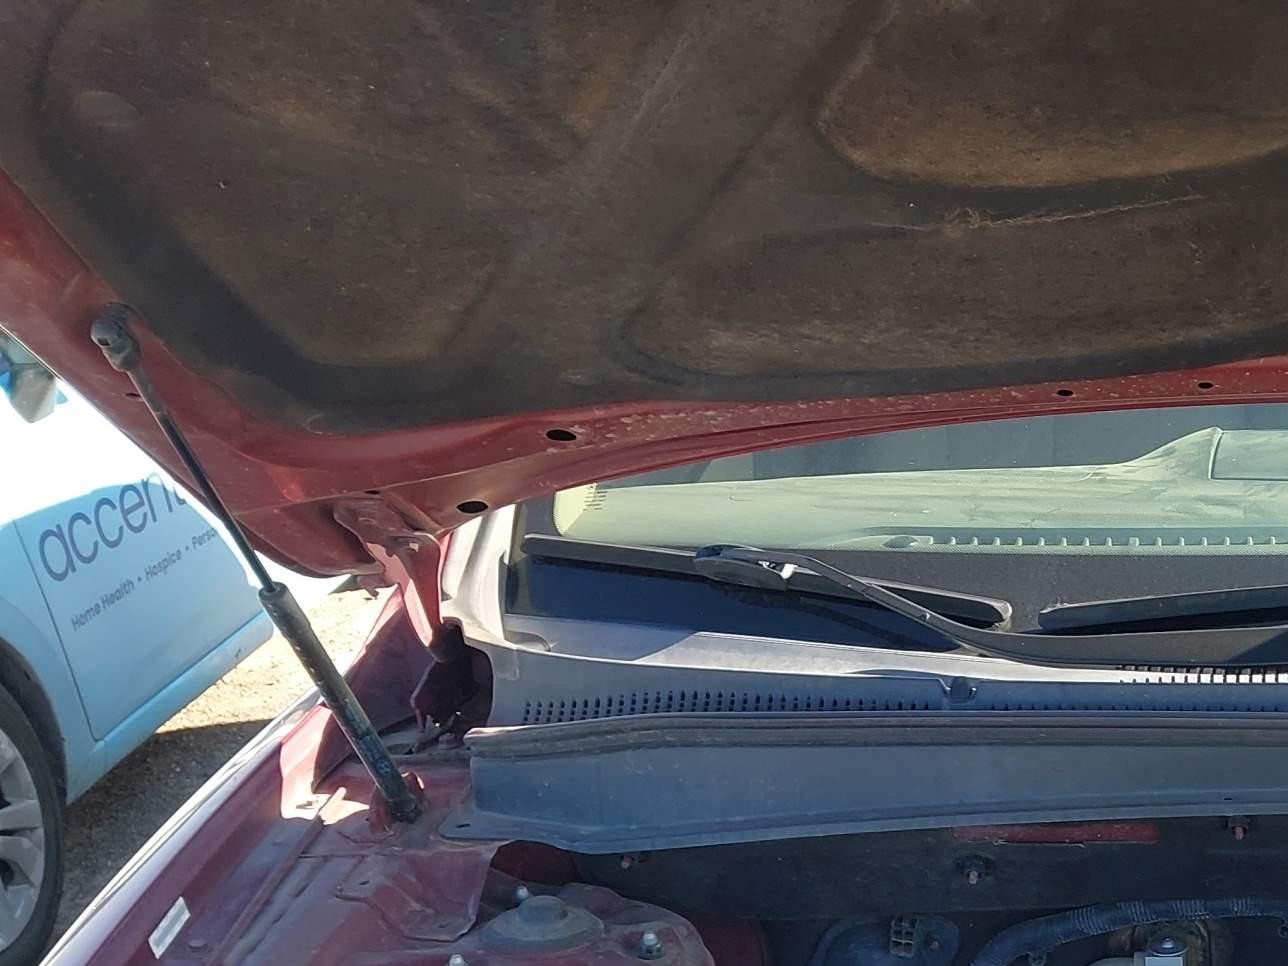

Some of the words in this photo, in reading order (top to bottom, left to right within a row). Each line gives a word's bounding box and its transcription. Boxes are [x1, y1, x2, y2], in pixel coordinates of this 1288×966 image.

[71, 604, 101, 632] Home
[101, 579, 136, 611] Health
[144, 549, 183, 580] Hospice
